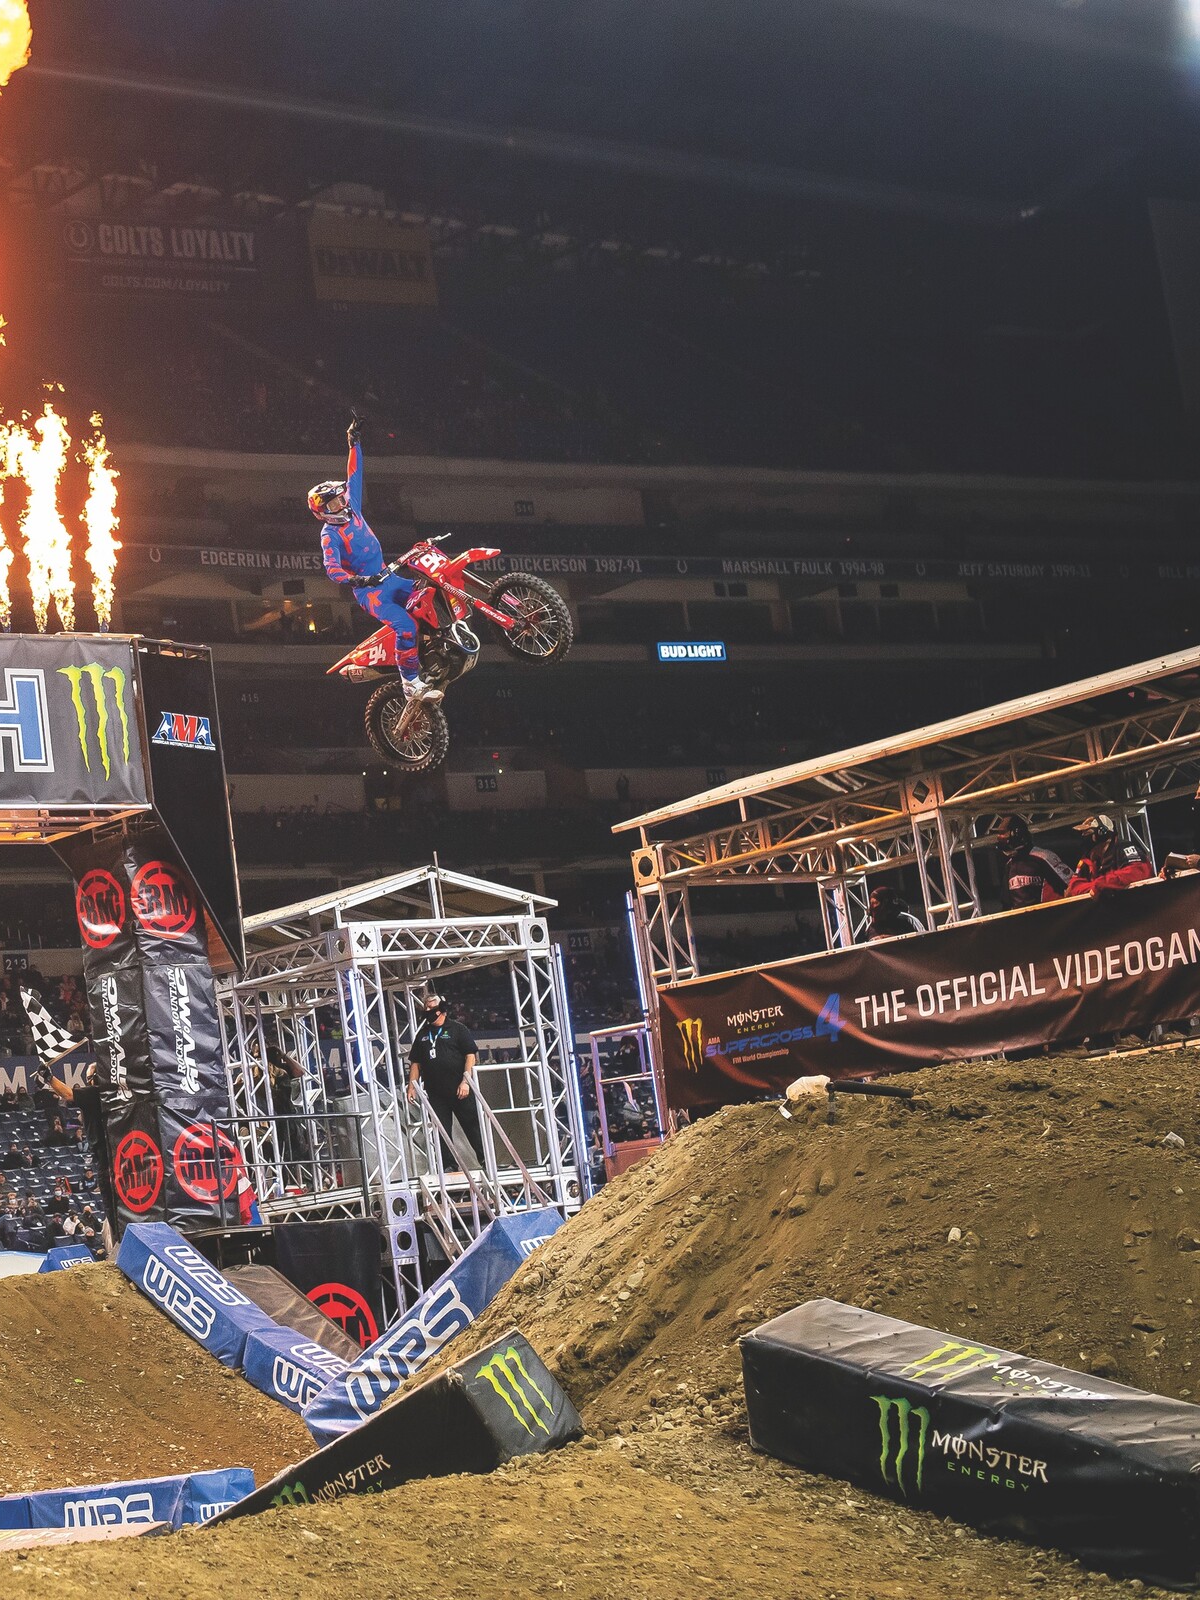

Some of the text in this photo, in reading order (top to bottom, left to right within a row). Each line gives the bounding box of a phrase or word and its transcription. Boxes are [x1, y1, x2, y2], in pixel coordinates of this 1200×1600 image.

[99, 224, 255, 262] COLTS LOYALTY
[200, 550, 322, 570] EDGERRIN JAMES
[473, 557, 643, 573] ERIC DICKERSON 1987-91
[721, 560, 885, 576] MARSHALL FAULK 1994-98
[956, 561, 984, 576] JEFF
[987, 561, 1044, 577] SATURDAY
[368, 643, 387, 666] 94
[660, 645, 722, 658] BUD LIGHT
[152, 711, 216, 747] AMA
[570, 936, 589, 946] 215
[855, 989, 907, 1028] THE
[917, 962, 1045, 1018] OFFICIAL
[101, 979, 118, 1084] ROCKY MOUNTAIN
[167, 967, 187, 1075] ROCKY MOUNTAIN
[704, 993, 847, 1059] SUPERCROSS 4
[726, 1004, 784, 1027] MONSTER
[737, 1020, 776, 1033] ENERGY
[707, 1035, 721, 1045] AMA
[732, 1047, 789, 1064] FIM World Championship
[164, 1245, 250, 1306] WPS
[143, 1254, 216, 1340] WPS
[345, 1279, 474, 1419] WPS
[932, 1429, 1049, 1484] MONSTER
[312, 1453, 392, 1503] MONSTER
[947, 1461, 1030, 1493] ENERGY
